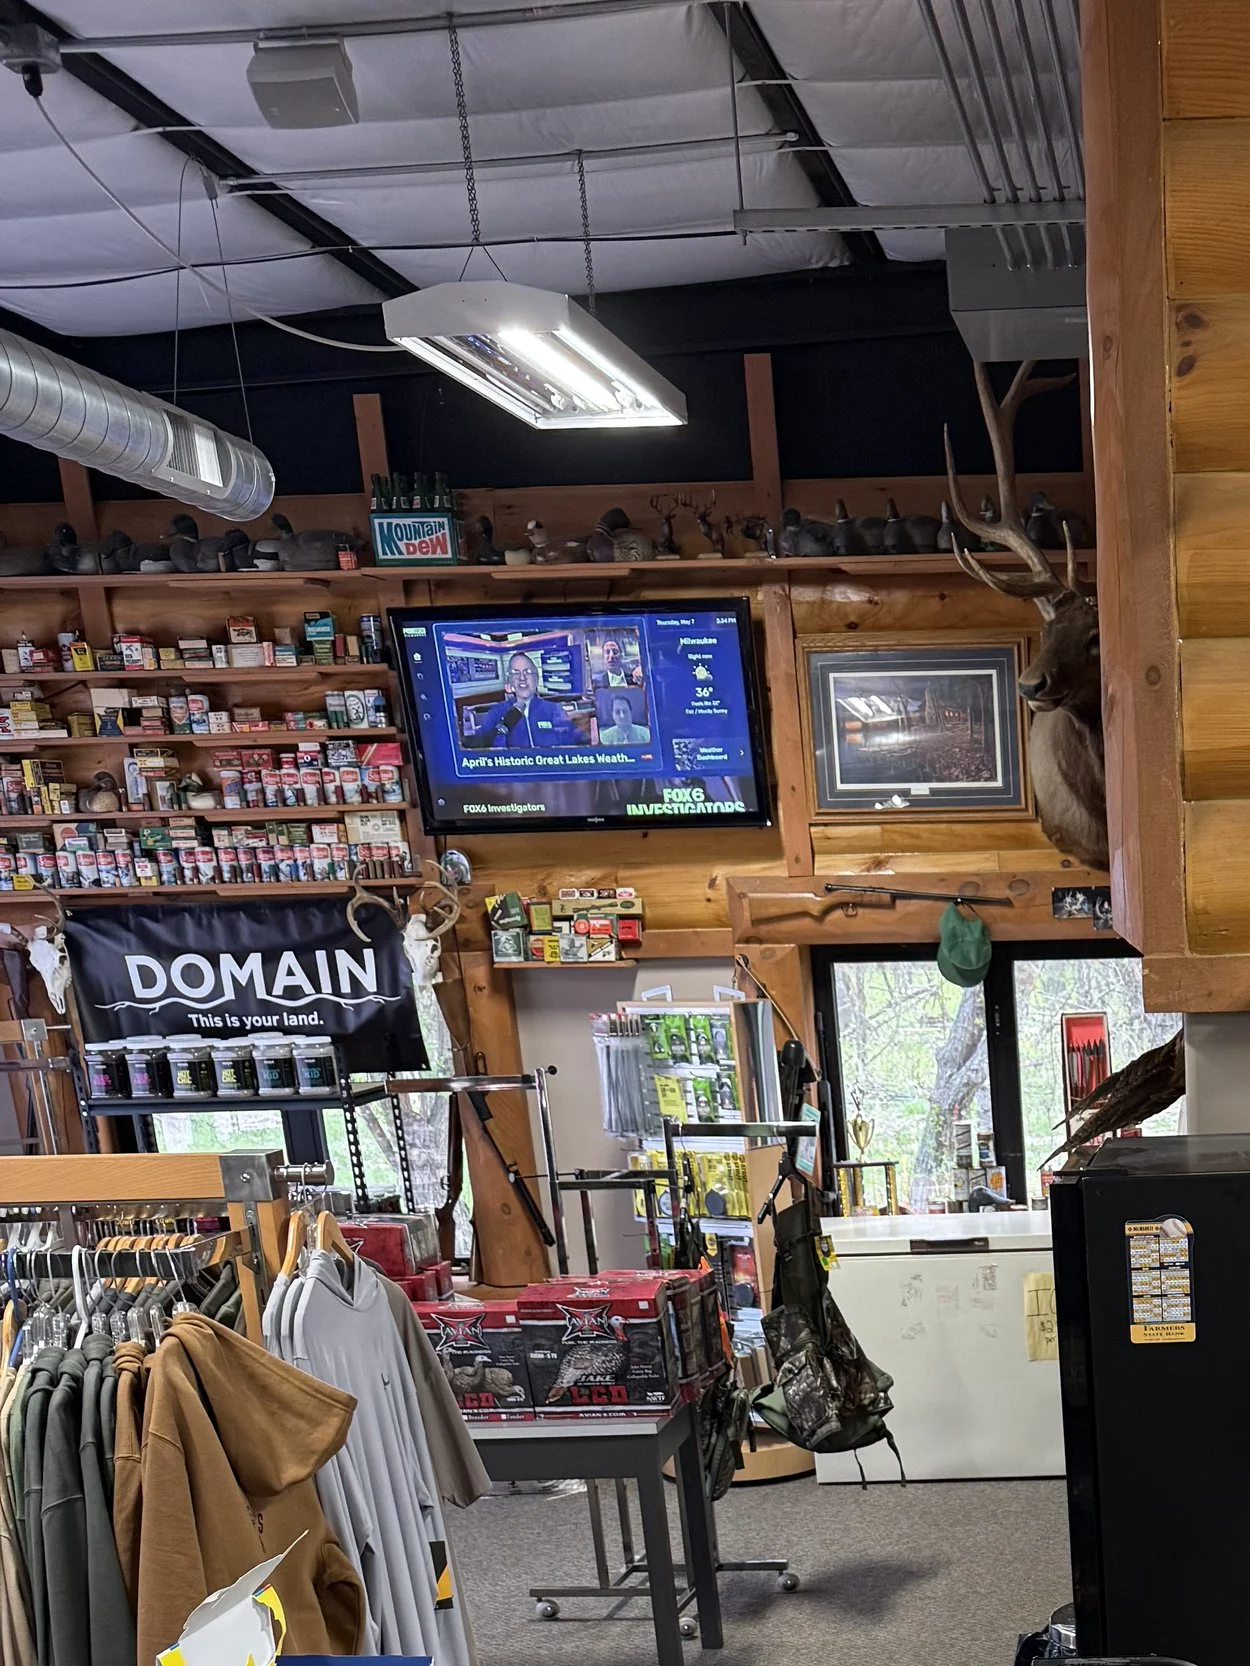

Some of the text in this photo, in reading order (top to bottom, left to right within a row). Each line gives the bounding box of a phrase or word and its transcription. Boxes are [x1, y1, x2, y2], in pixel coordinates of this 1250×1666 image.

[680, 637, 717, 645] Milwaukee
[462, 755, 494, 768] April's
[494, 754, 534, 766] Historic
[535, 753, 566, 766] Great
[566, 753, 595, 765] Lakes
[663, 787, 705, 802] FOX6
[463, 802, 546, 815] FOX6 Investigators
[125, 947, 378, 1001] DOMAIN
[188, 1010, 324, 1030] This is your land.
[570, 1317, 608, 1327] AVIAN
[444, 1326, 482, 1336] AVIAN
[577, 1374, 616, 1383] JAKE
[570, 1385, 628, 1405] LCD
